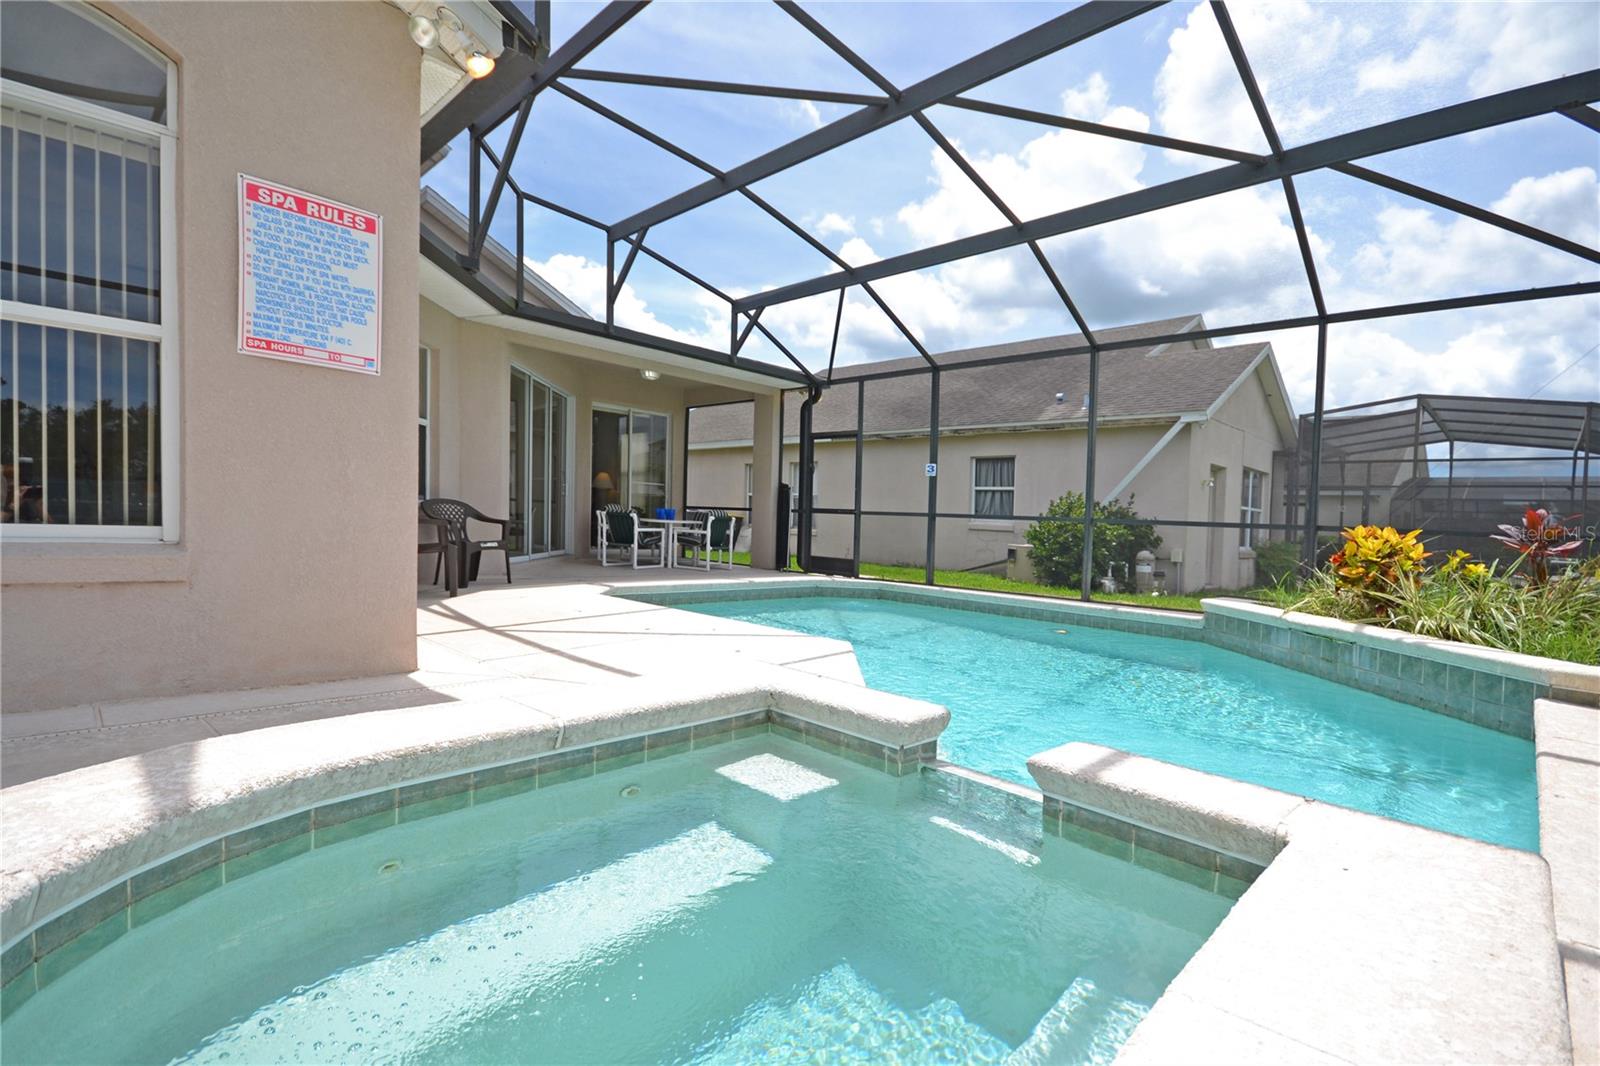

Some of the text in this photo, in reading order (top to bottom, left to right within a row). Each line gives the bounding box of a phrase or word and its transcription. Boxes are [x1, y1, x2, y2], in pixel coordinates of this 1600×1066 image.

[258, 188, 366, 231] SPA RULES
[247, 338, 267, 349] SPA
[271, 342, 303, 355] HOURS
[927, 464, 935, 472] 3
